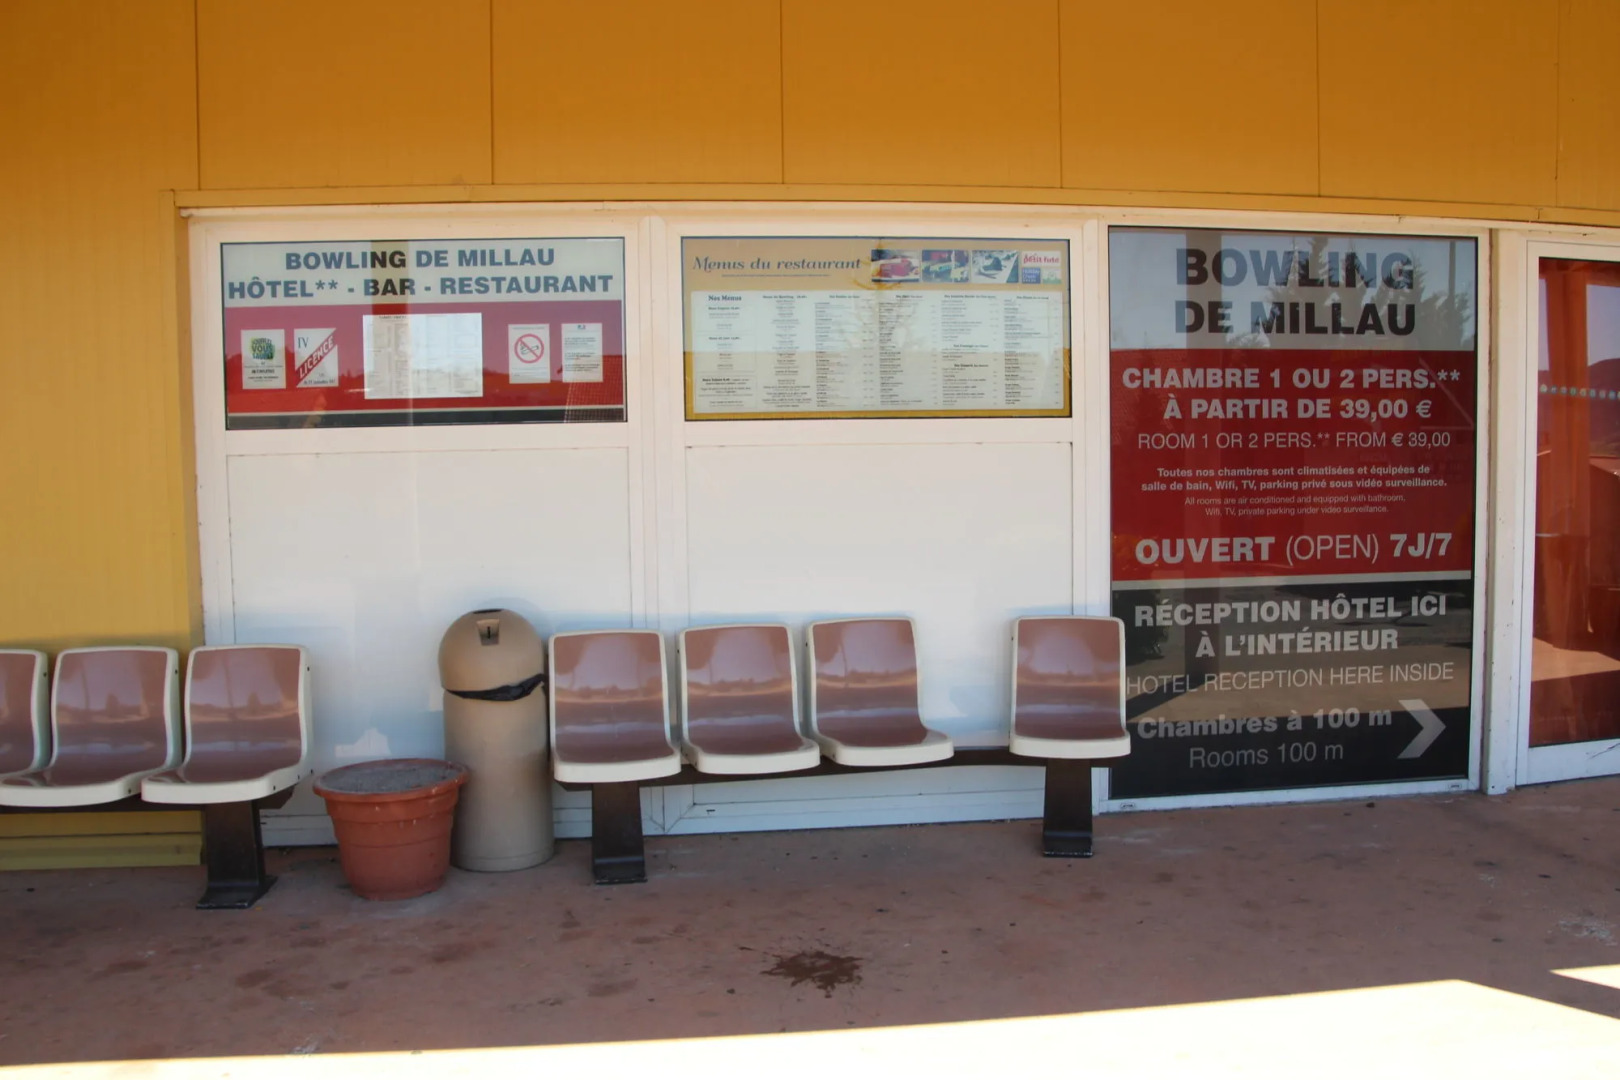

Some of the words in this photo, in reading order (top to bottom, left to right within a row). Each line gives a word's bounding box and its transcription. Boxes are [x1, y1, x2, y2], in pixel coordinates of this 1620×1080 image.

[286, 251, 406, 270] BOWLING
[416, 250, 449, 268] DE
[458, 248, 555, 267] MILLAU
[692, 256, 745, 273] Menus
[750, 258, 770, 270] du
[777, 258, 862, 270] restaurant
[1176, 248, 1414, 290] BOWLING
[364, 278, 416, 296] BAR
[440, 275, 614, 295] RESTAURANT
[1175, 300, 1233, 334] DE
[1251, 301, 1416, 336] MILLAU
[298, 337, 309, 348] IV
[299, 335, 335, 379] LICENCE
[1122, 368, 1260, 389] CHAMBRE
[1270, 368, 1281, 388] 1
[1292, 368, 1330, 389] OU
[1339, 369, 1355, 389] 2
[1163, 393, 1182, 419] À
[1191, 399, 1288, 419] PARTIR
[1297, 399, 1331, 418] DE
[1339, 399, 1408, 422] 39,00
[1416, 400, 1432, 418] €
[1138, 433, 1195, 449] ROOM
[1202, 433, 1208, 448] 1
[1216, 433, 1242, 449] OR
[1249, 433, 1258, 448] 2
[1336, 432, 1386, 448] FROM
[1391, 432, 1403, 446] €
[1408, 432, 1451, 449] 39,00
[1157, 468, 1192, 477] Toutes
[1196, 469, 1214, 477] nos
[1218, 467, 1269, 476] chambres
[1272, 466, 1294, 475] sont
[1297, 466, 1354, 475] climatisées
[1357, 466, 1368, 474] et
[1370, 465, 1415, 477] équipées
[1418, 465, 1430, 474] de
[1141, 481, 1167, 491] salle
[1170, 481, 1183, 490] de
[1186, 481, 1212, 491] bain,
[1215, 480, 1238, 491] Wifi,
[1242, 480, 1257, 490] TV,
[1260, 480, 1299, 490] parking
[1302, 479, 1326, 490] privé
[1356, 478, 1382, 487] vidéo
[1385, 478, 1447, 487] surveillance.
[1185, 497, 1195, 505] All
[1238, 496, 1247, 504] air
[1249, 495, 1295, 504] conditioned
[1313, 495, 1349, 504] equipped
[1238, 507, 1265, 516] private
[1267, 507, 1295, 516] parking
[1297, 506, 1319, 514] under
[1321, 505, 1341, 513] video
[1343, 505, 1389, 513] surveillance.
[1135, 536, 1275, 564] OUVERT
[1286, 533, 1379, 566] (OPEN)
[1389, 533, 1452, 559] 7J/7
[1135, 599, 1300, 627] RÉCEPTION
[1311, 593, 1402, 620] HÔTEL
[1411, 595, 1446, 617] ICI
[1195, 630, 1216, 658] À
[1225, 627, 1398, 657] L'INTÉRIEUR
[1127, 674, 1198, 694] HOTEL
[1204, 668, 1323, 691] RECEPTION
[1330, 665, 1384, 685] HERE
[1390, 662, 1454, 682] INSIDE
[1137, 714, 1278, 739] Chambres
[1287, 710, 1302, 731] à
[1313, 707, 1360, 729] 100
[1369, 709, 1392, 726] m
[1189, 747, 1269, 768] Rooms
[1278, 742, 1317, 763] 100
[1325, 744, 1343, 760] m
